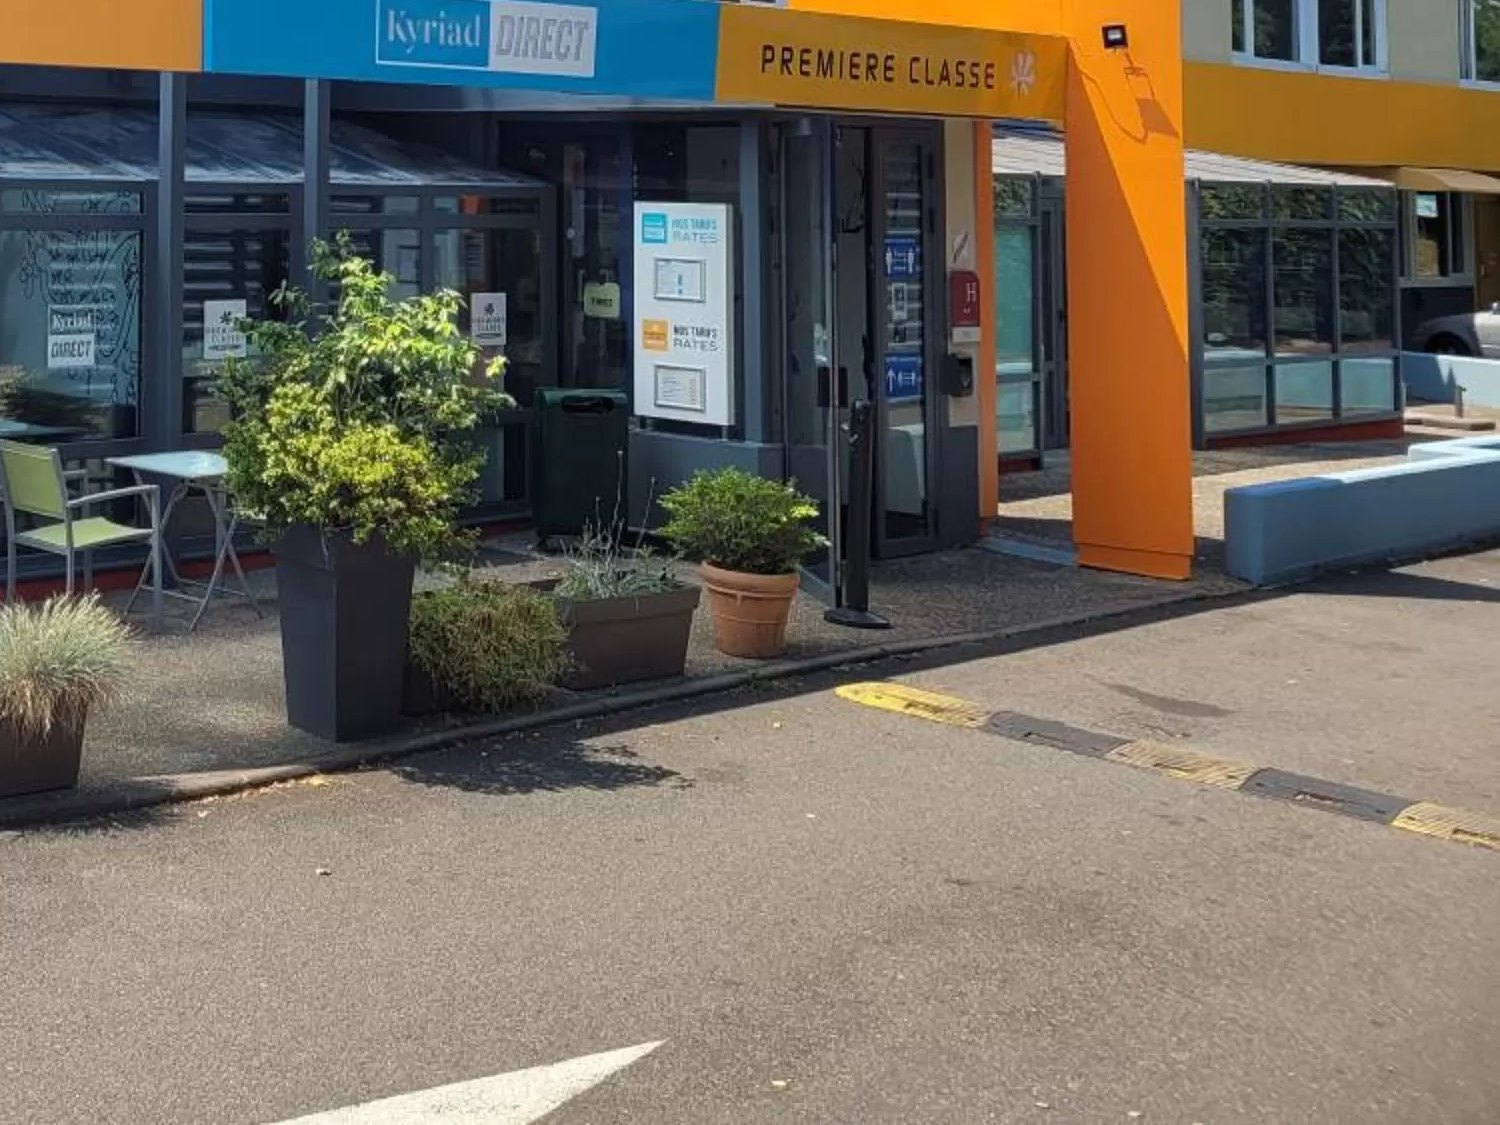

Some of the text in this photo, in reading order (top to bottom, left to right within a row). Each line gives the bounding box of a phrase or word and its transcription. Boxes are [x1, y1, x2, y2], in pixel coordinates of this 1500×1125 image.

[387, 8, 589, 62] Kyriad DIRECT
[761, 43, 996, 90] PREMIERE CLASSE
[673, 231, 719, 244] RATES
[51, 341, 93, 359] DIRECT
[673, 338, 719, 351] RATES
